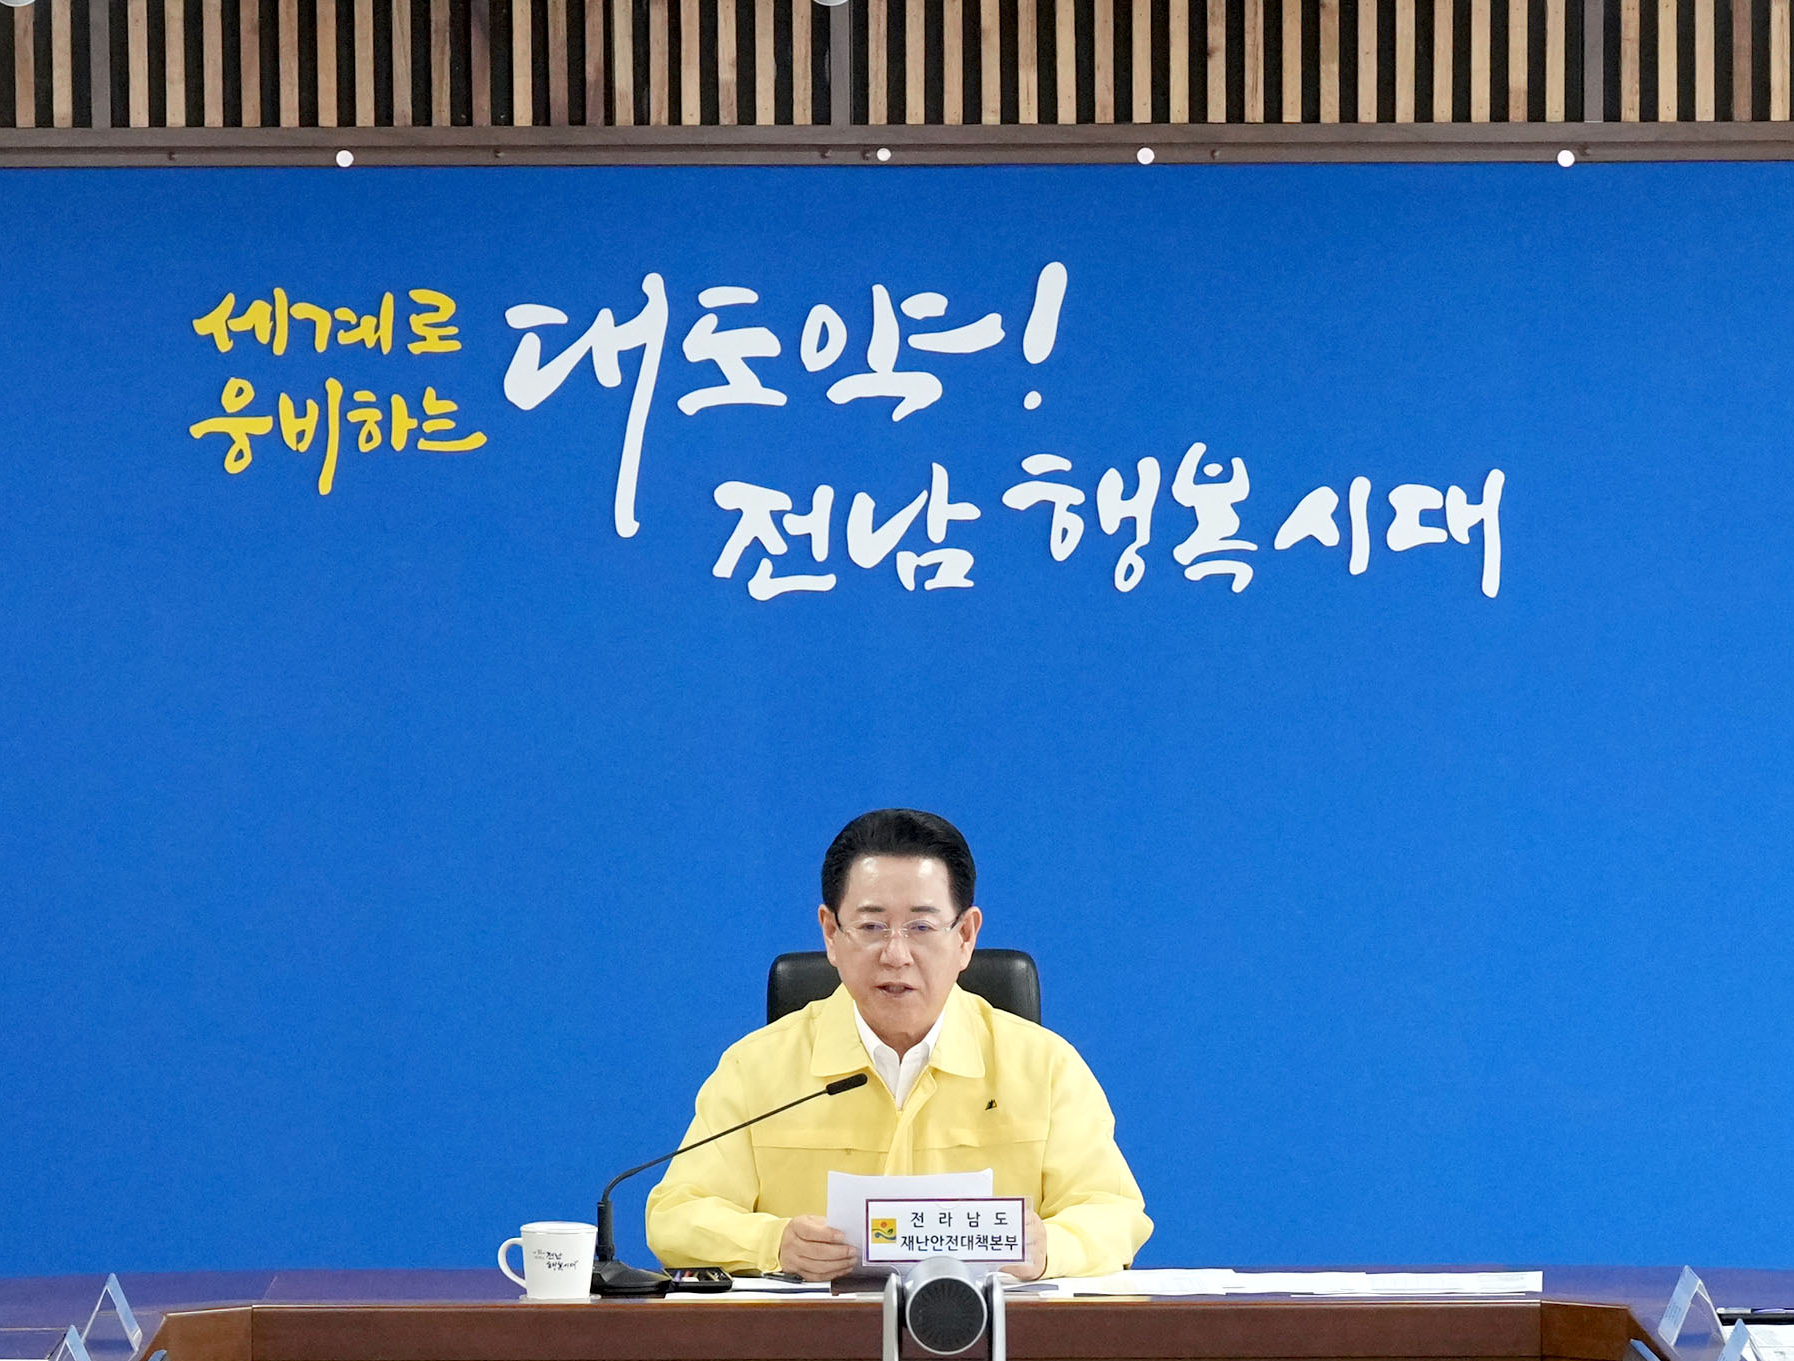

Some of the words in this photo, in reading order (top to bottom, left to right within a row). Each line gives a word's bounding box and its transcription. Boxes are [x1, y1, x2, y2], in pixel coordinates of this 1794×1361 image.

[192, 287, 463, 356] 세계로
[189, 376, 488, 496] 웅비하는
[503, 261, 1068, 539] 대도약!
[712, 462, 982, 602] 전남
[901, 1234, 1019, 1252] 재난안전대책본부
